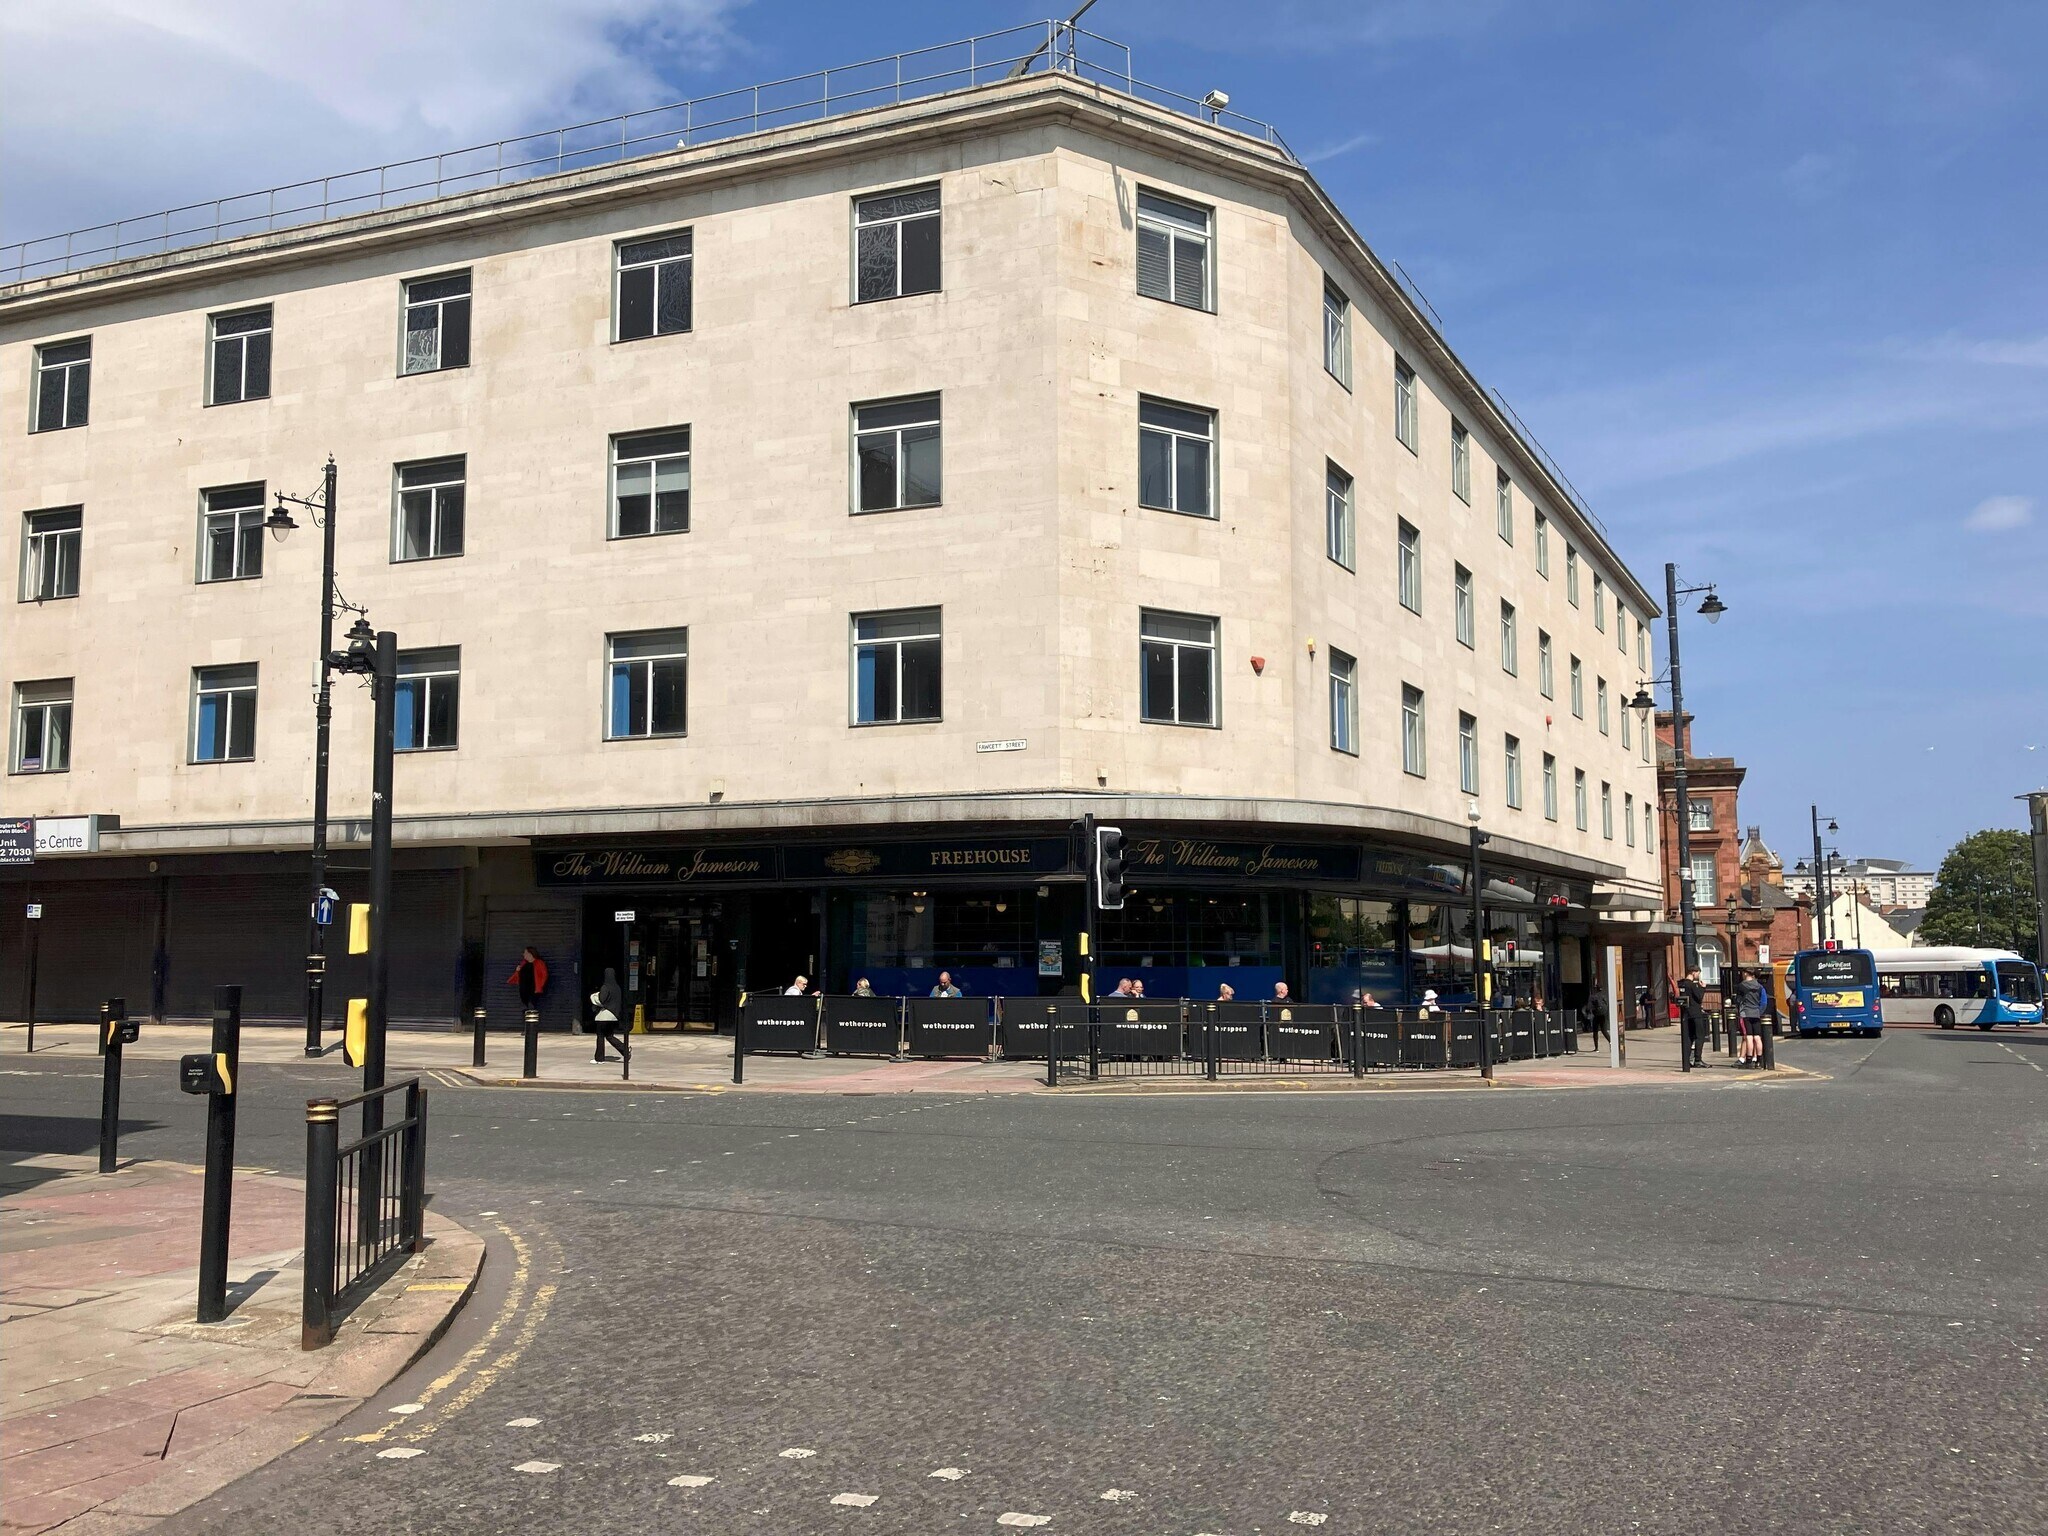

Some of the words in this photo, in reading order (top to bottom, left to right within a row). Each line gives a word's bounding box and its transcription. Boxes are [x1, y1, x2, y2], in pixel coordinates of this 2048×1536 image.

[48, 834, 83, 848] Centre
[8, 848, 31, 856] 7030
[931, 849, 1031, 866] FREEHOUSE
[1125, 839, 1165, 865] The
[1172, 839, 1240, 867] William
[1245, 843, 1320, 875] Jameson
[553, 852, 592, 876] The
[600, 851, 670, 875] William
[678, 849, 760, 882] Jameson
[839, 1020, 887, 1028] wetherspoon
[922, 1022, 975, 1030] wetherspoon
